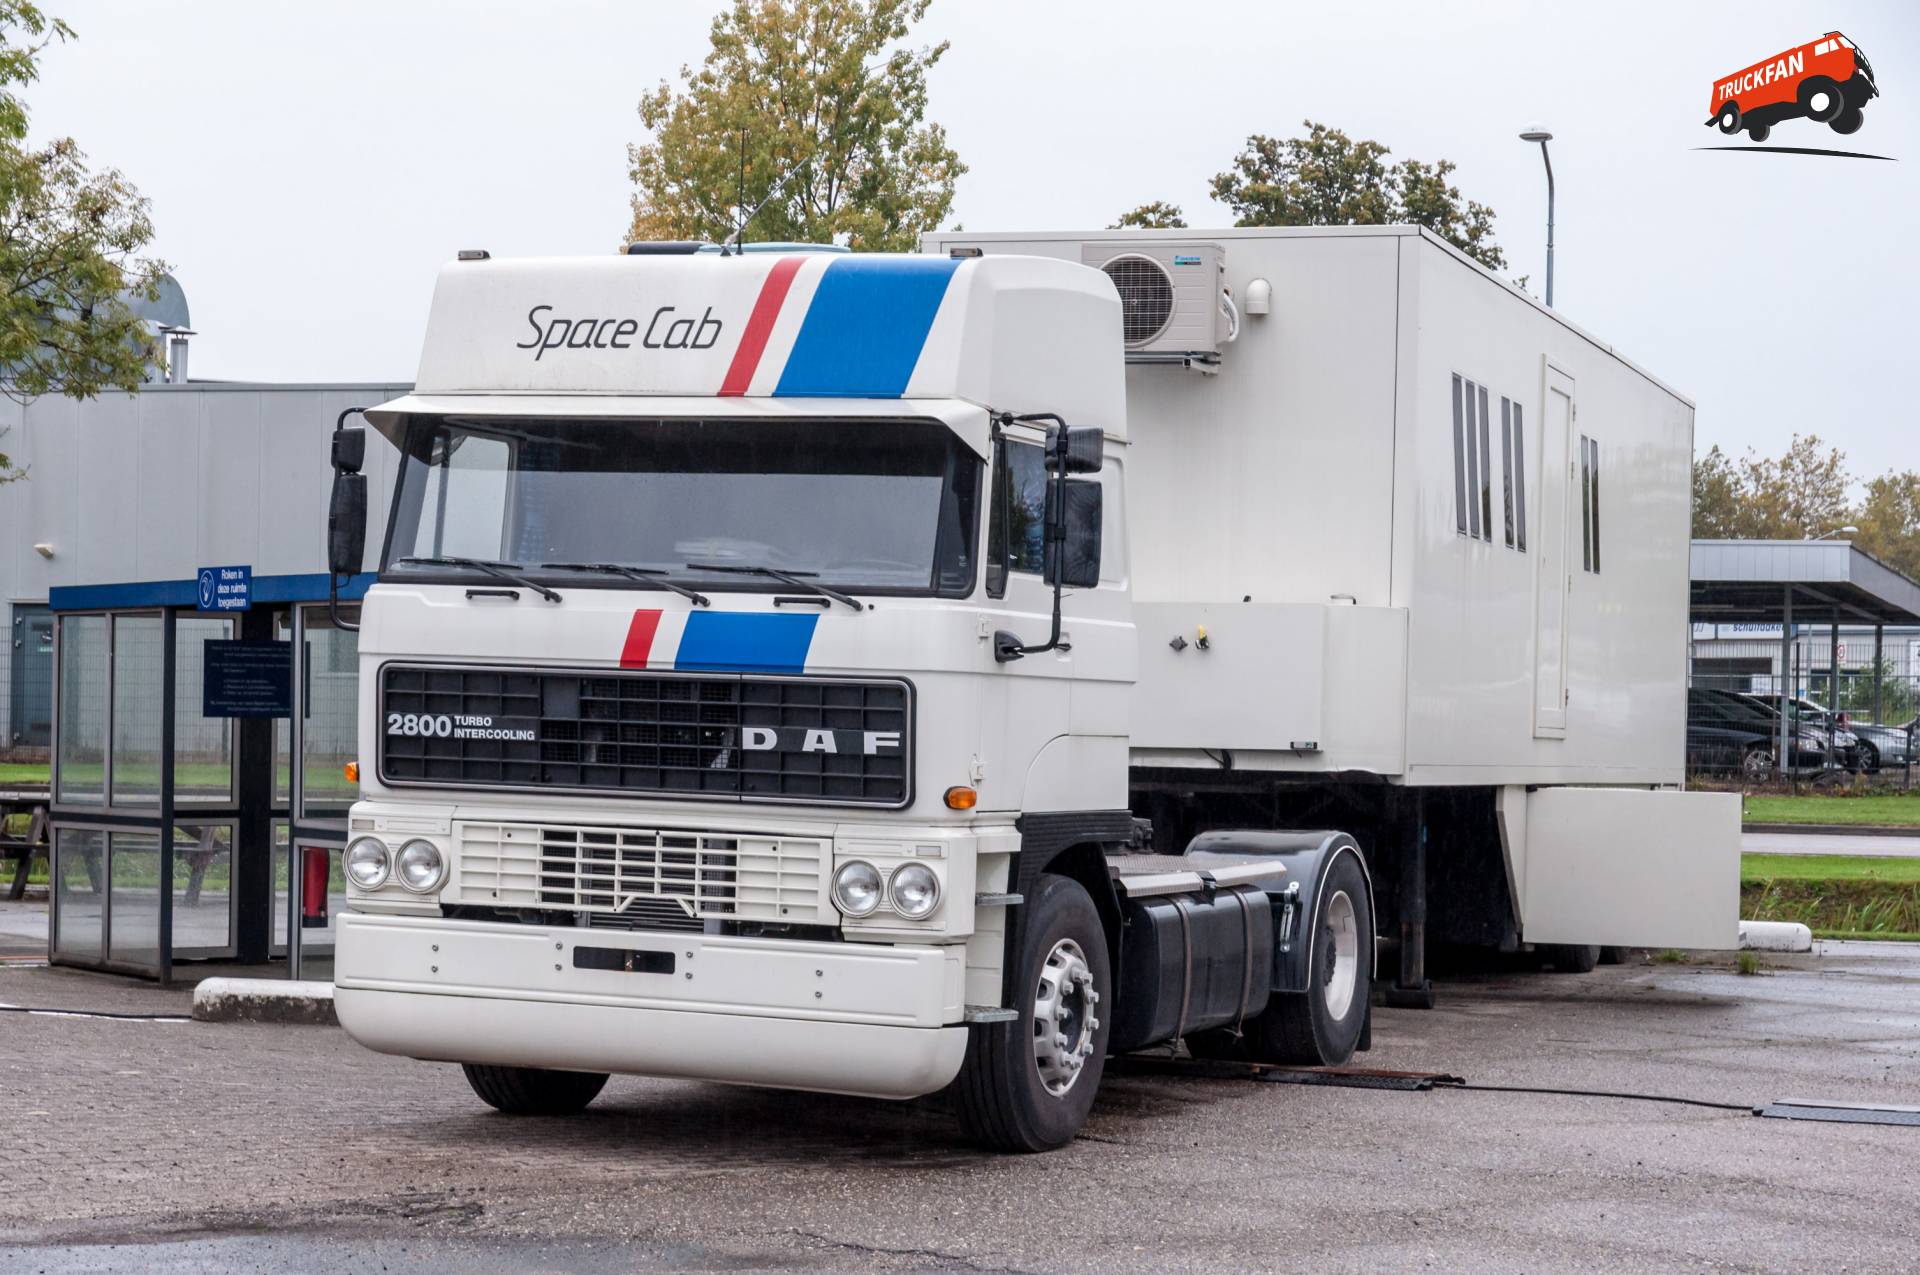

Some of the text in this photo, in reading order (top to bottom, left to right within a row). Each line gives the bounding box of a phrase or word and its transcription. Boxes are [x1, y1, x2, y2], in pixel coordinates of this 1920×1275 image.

[516, 305, 723, 362] Space Cab
[221, 569, 244, 580] Roken in
[217, 582, 247, 594] deze ruimte
[217, 597, 247, 609] toegestaan
[387, 713, 493, 737] 2800 TURBO
[453, 728, 536, 741] INTERCOOLING
[741, 727, 901, 755] DAF
